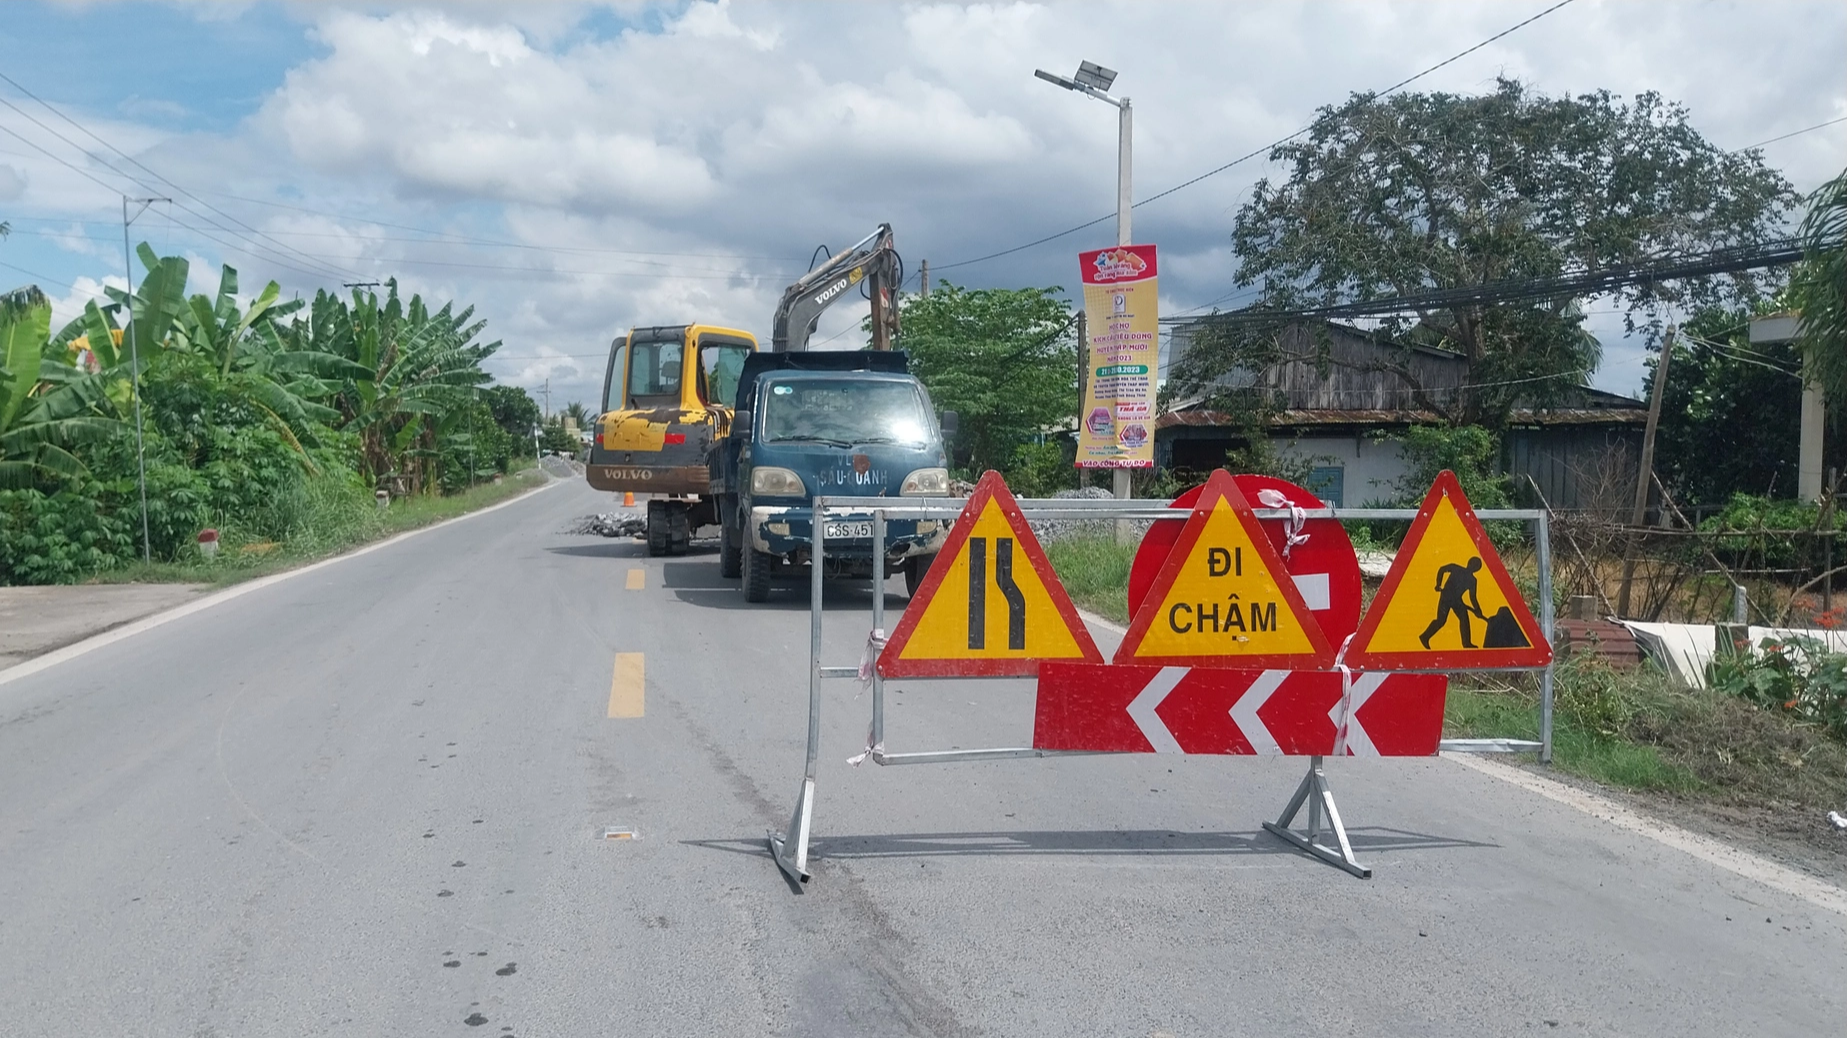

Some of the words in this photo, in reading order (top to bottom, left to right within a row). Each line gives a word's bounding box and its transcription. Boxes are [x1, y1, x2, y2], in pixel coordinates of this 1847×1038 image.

[815, 279, 847, 304] VOLVO
[604, 469, 652, 480] VOLVO
[1207, 546, 1242, 577] ĐI
[1168, 593, 1277, 641] CHẬM
